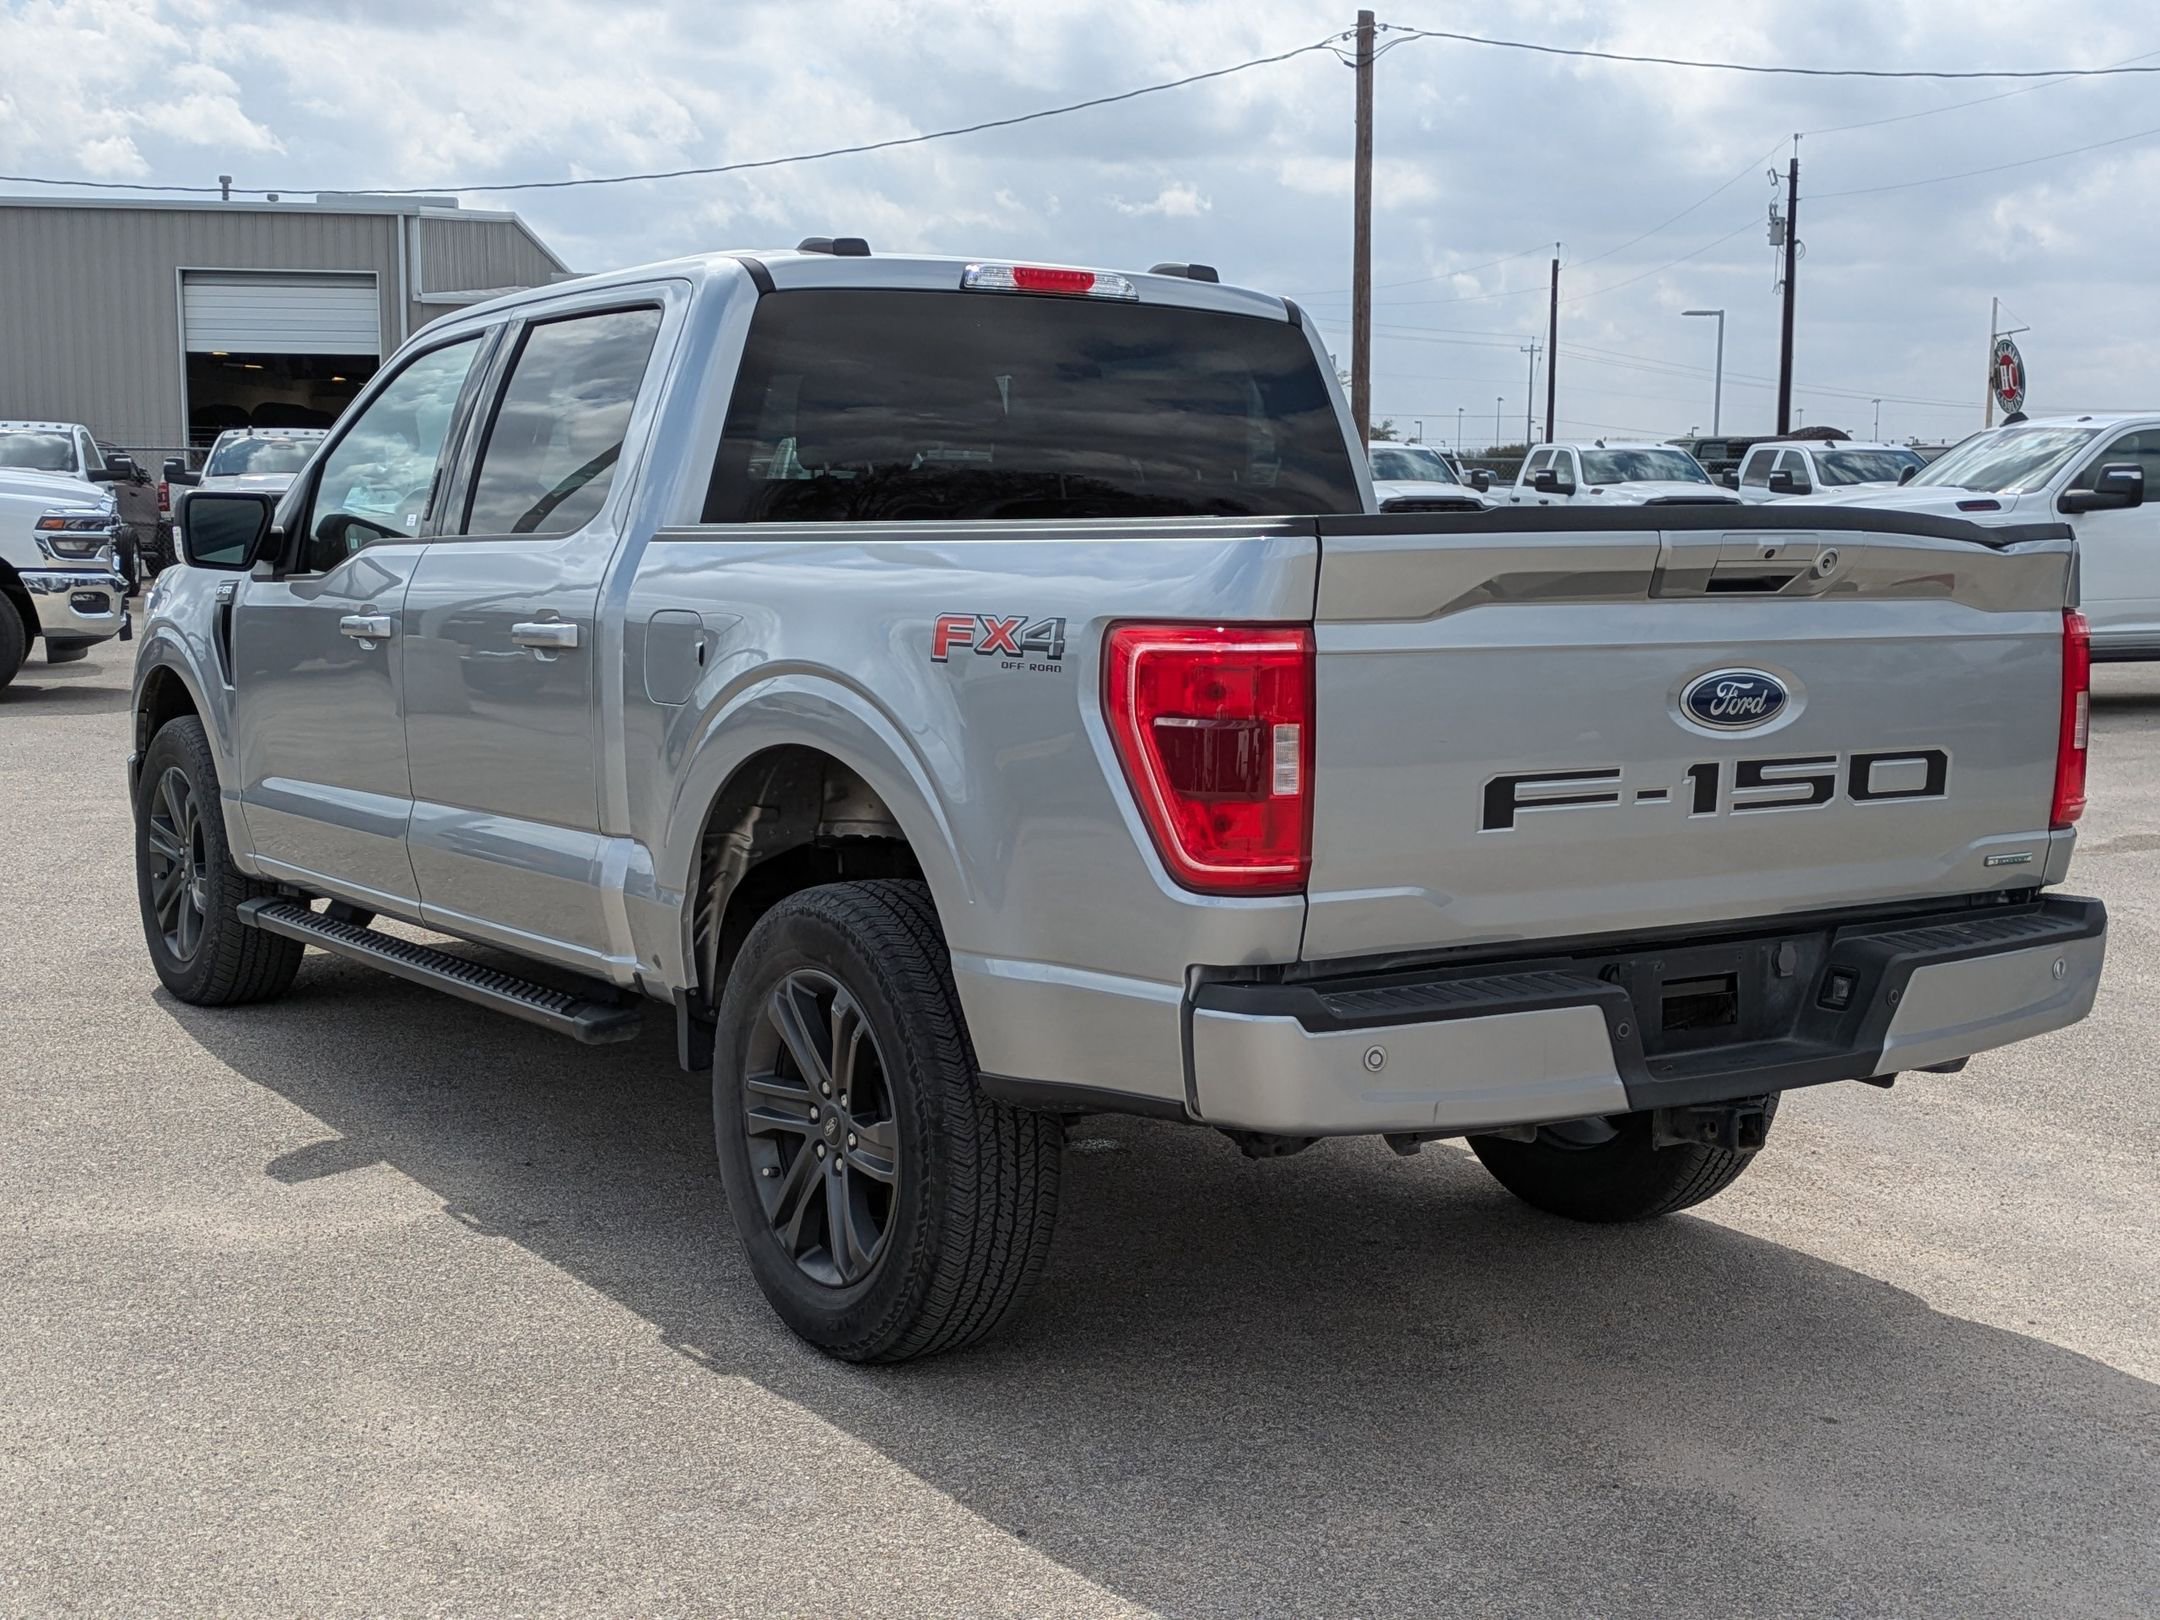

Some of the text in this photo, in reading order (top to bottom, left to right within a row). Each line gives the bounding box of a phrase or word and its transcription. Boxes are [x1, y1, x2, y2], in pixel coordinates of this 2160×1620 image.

[931, 612, 1066, 662] FX4
[1001, 661, 1062, 672] OFF ROAD
[1710, 681, 1768, 716] Ford
[1482, 749, 1949, 830] F-150
